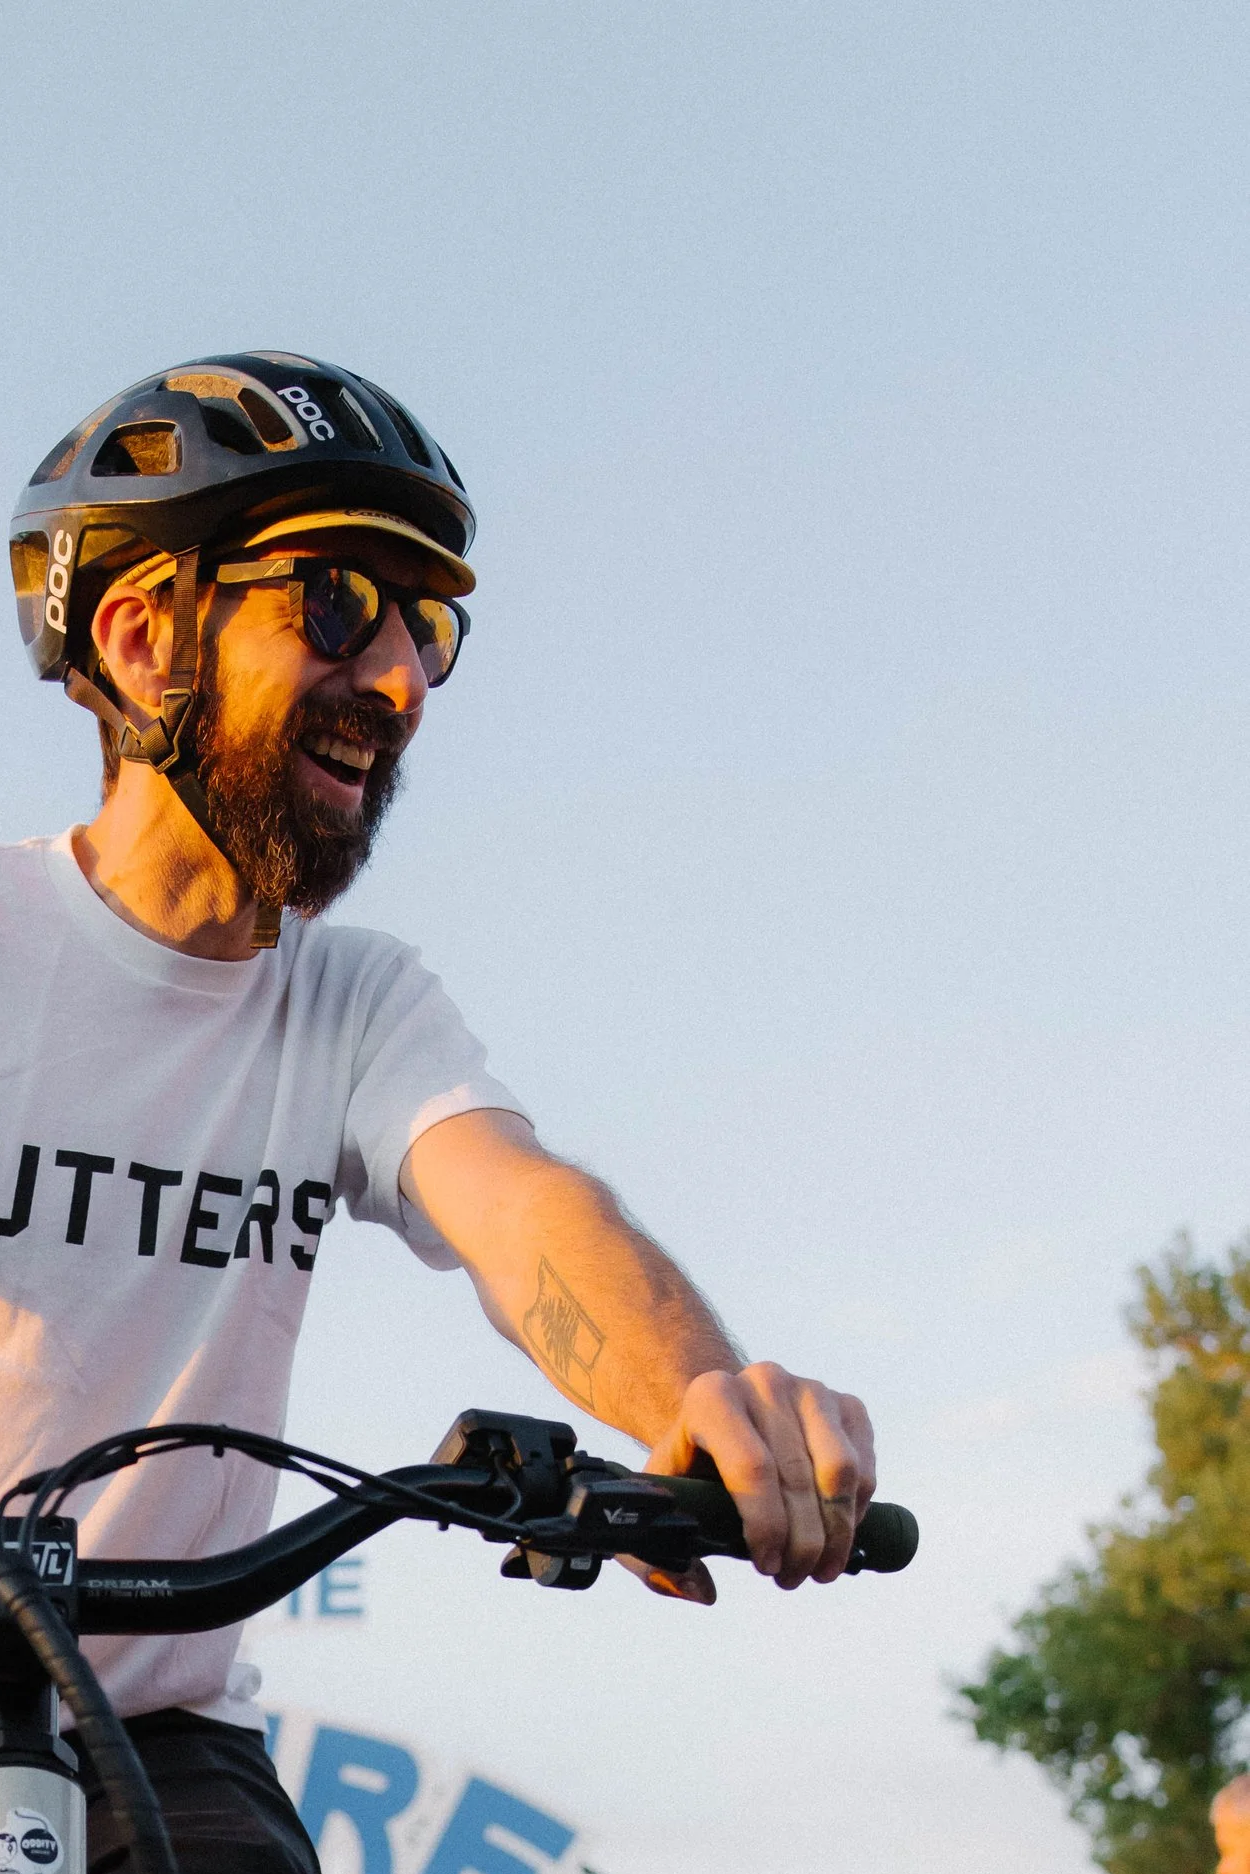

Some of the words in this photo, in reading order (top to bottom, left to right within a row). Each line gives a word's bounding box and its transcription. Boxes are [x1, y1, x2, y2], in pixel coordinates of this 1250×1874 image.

[276, 386, 335, 441] POC
[46, 529, 72, 635] POC
[87, 1579, 171, 1589] DREAM
